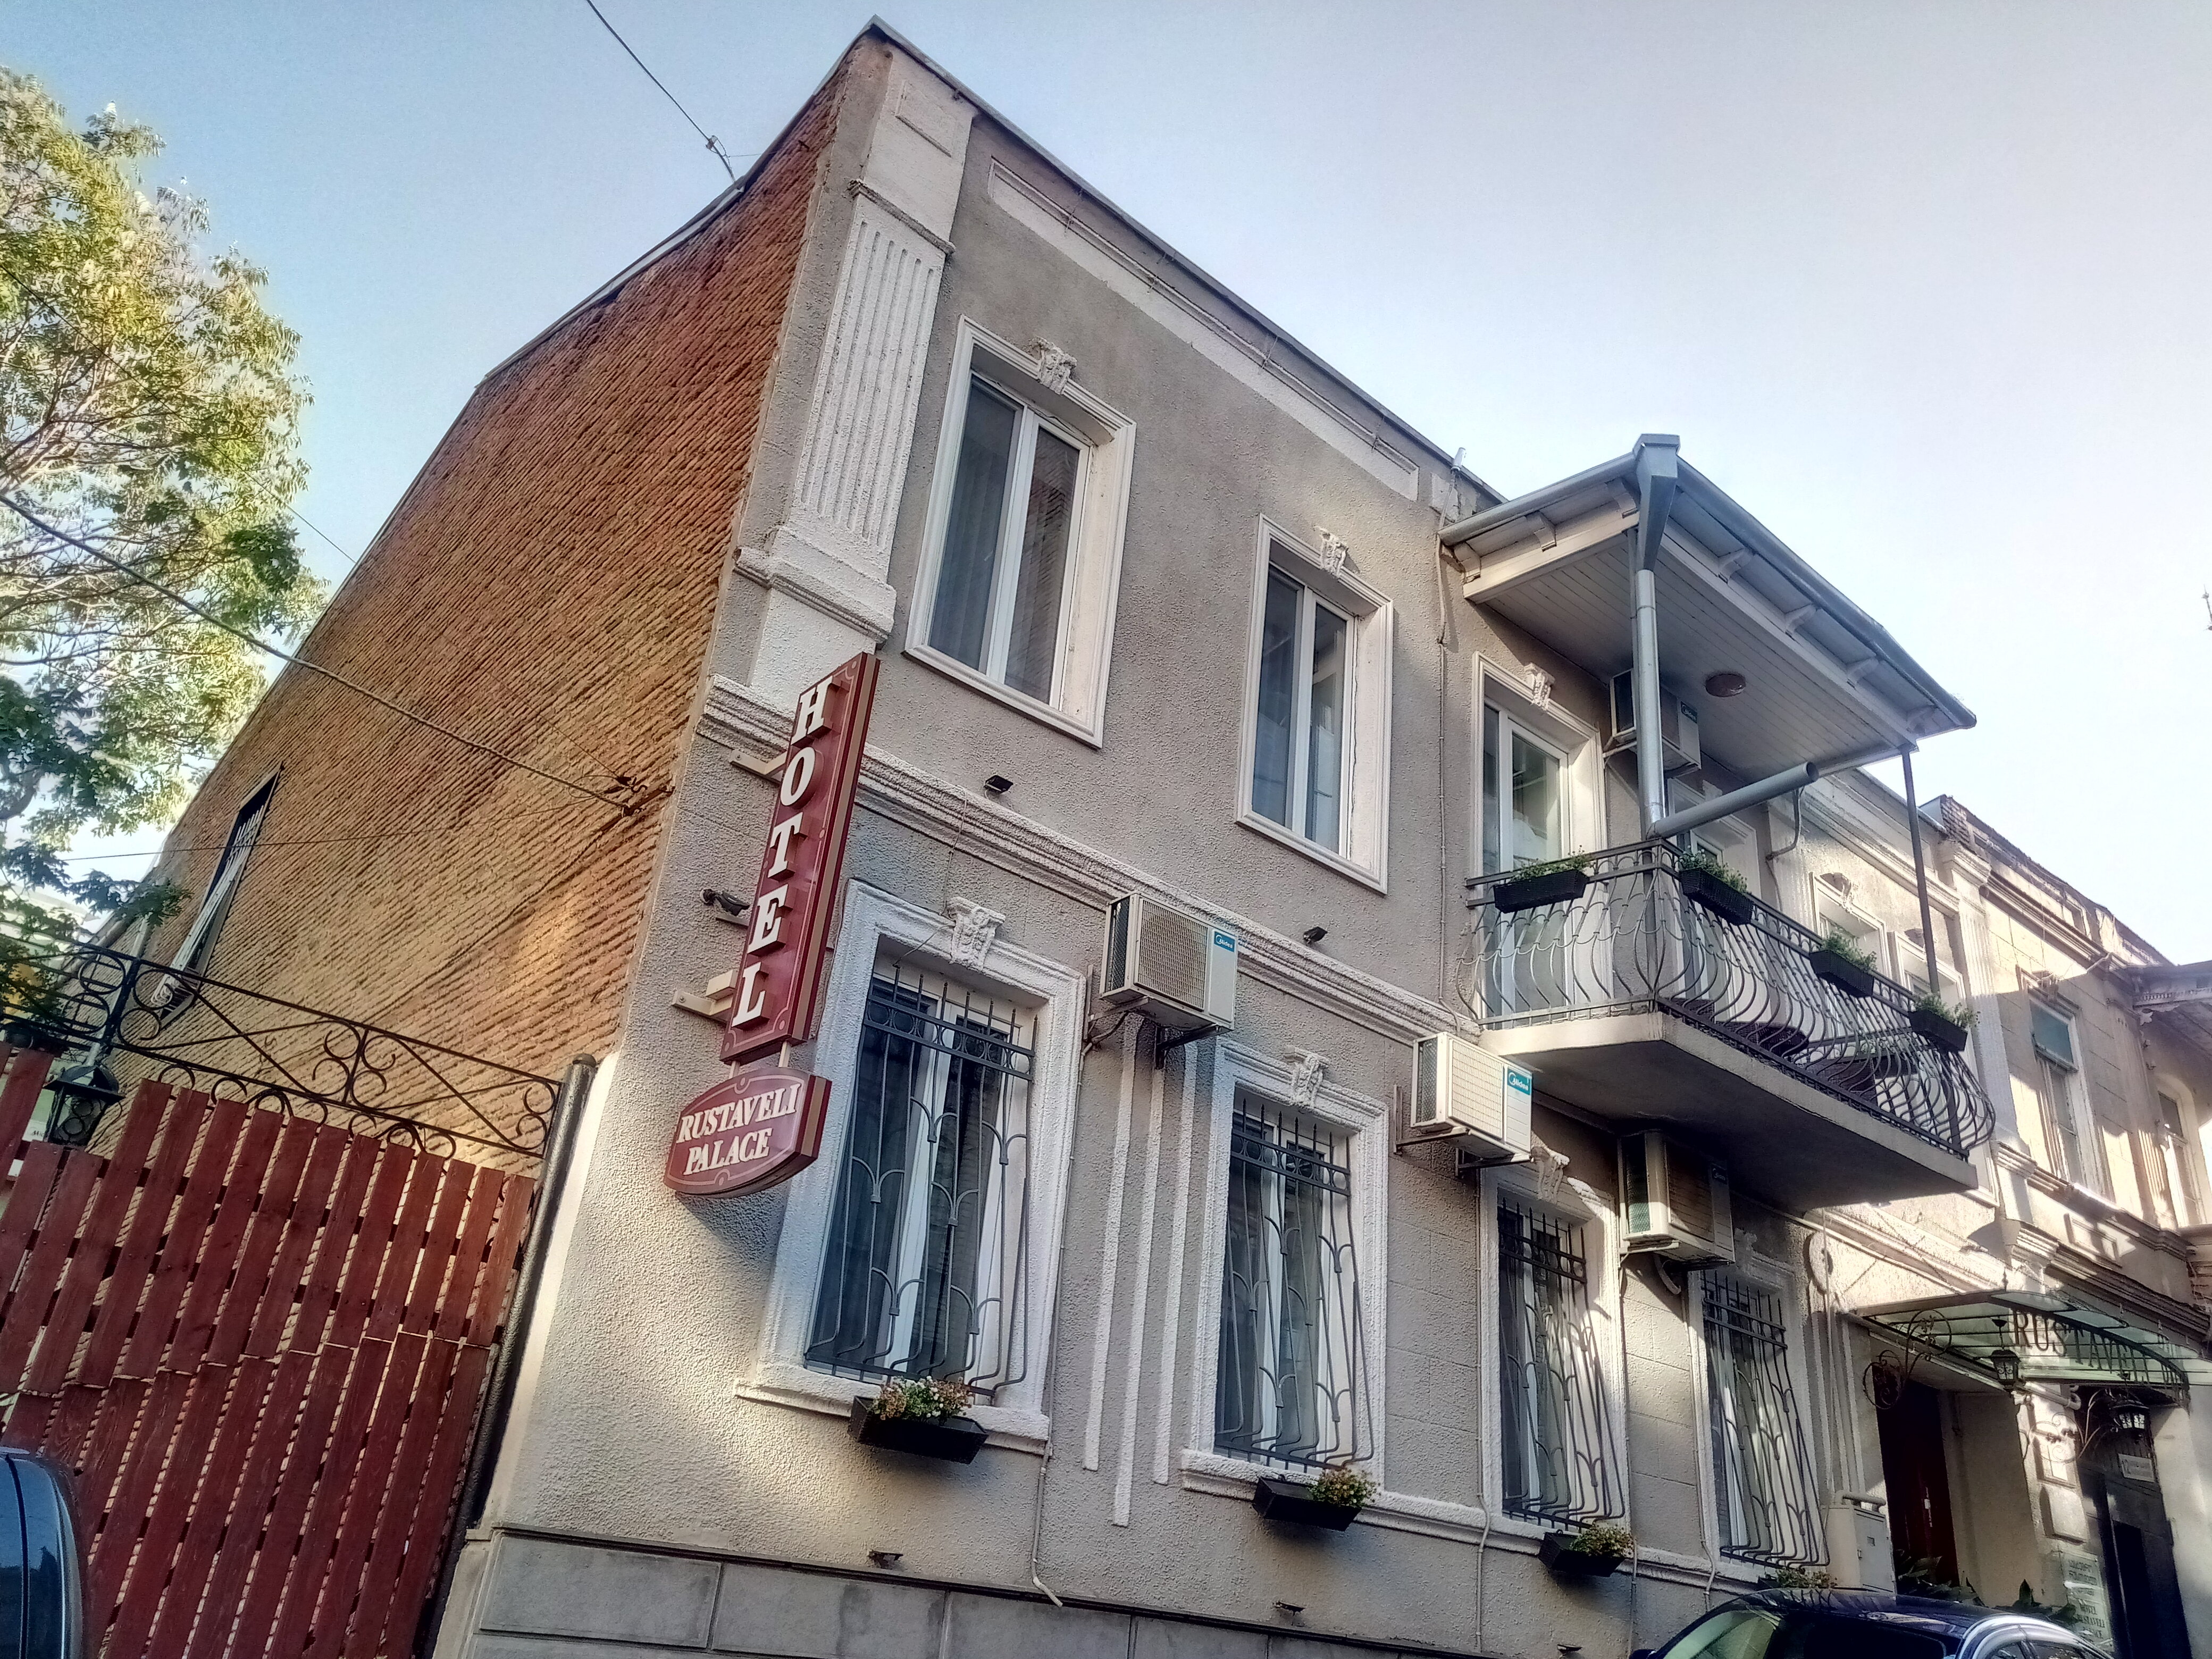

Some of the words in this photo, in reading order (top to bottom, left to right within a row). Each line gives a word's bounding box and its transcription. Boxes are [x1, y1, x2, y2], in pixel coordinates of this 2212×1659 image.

[731, 675, 834, 1028] HOTEL
[1216, 935, 1233, 949] Midea
[1509, 1072, 1529, 1091] Midea
[675, 1083, 802, 1144] RUSTAVELI
[683, 1127, 774, 1176] PALACE
